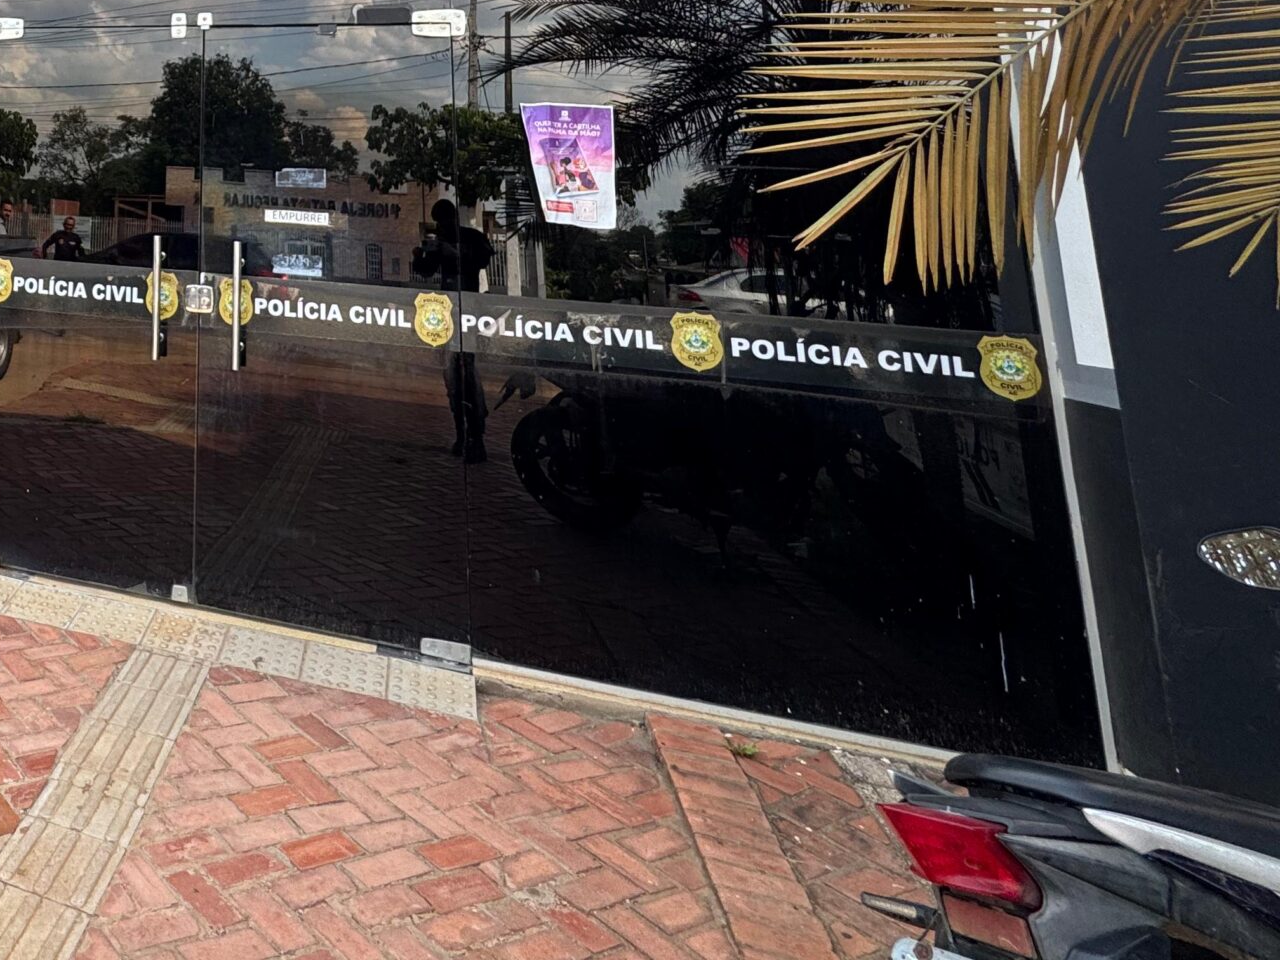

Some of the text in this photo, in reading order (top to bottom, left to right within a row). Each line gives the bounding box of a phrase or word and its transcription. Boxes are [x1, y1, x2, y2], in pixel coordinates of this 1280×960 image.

[272, 210, 327, 223] EMPURRE!
[13, 275, 87, 299] POLÍCIA
[92, 284, 144, 304] CIVIL
[254, 297, 412, 328] POLÍCIA CIVIL
[680, 317, 710, 325] POLÍCIA
[461, 314, 663, 350] POLÍCIA CIVIL
[990, 341, 1024, 351] POLÍCIA
[687, 354, 708, 362] CIVIL
[730, 336, 976, 378] POLÍCIA CIVIL
[1000, 383, 1026, 391] CIVIL
